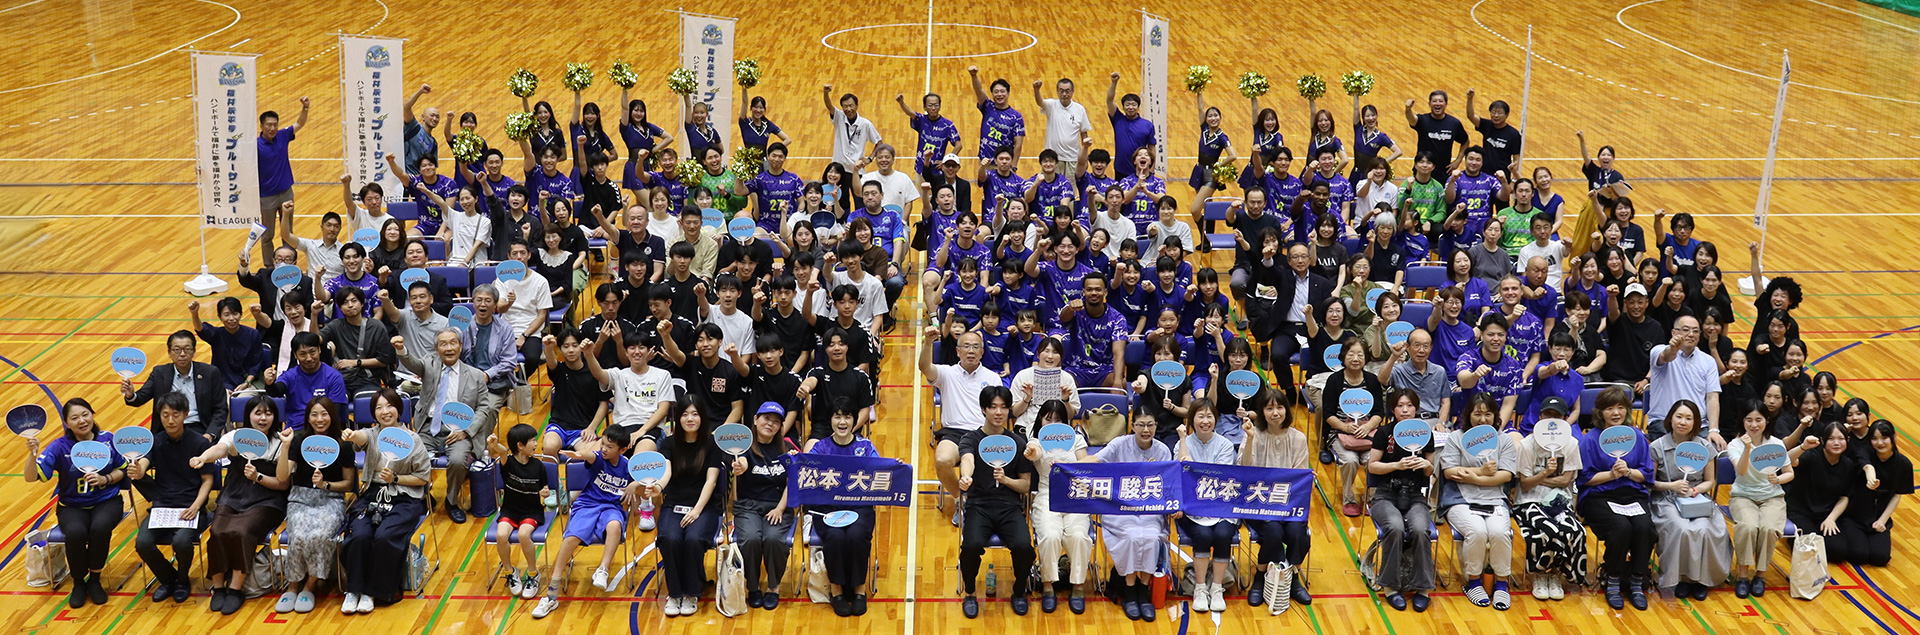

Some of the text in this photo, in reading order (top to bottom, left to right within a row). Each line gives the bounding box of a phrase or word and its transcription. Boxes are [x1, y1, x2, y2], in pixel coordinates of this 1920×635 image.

[713, 198, 727, 210] 33
[769, 199, 784, 211] 27
[1135, 199, 1148, 212] 19
[1467, 197, 1481, 210] 23
[427, 206, 439, 217] 15
[1044, 205, 1054, 217] 31
[217, 216, 260, 225] LEAGUE H
[798, 467, 842, 490] 松本
[846, 470, 893, 492] 大昌
[1068, 474, 1163, 500] 落田 駿兵
[1196, 476, 1292, 505] 松本 大昌
[893, 492, 906, 502] 15
[1165, 500, 1180, 511] 23
[1232, 507, 1304, 517] Hiromasa Matsumoto 15
